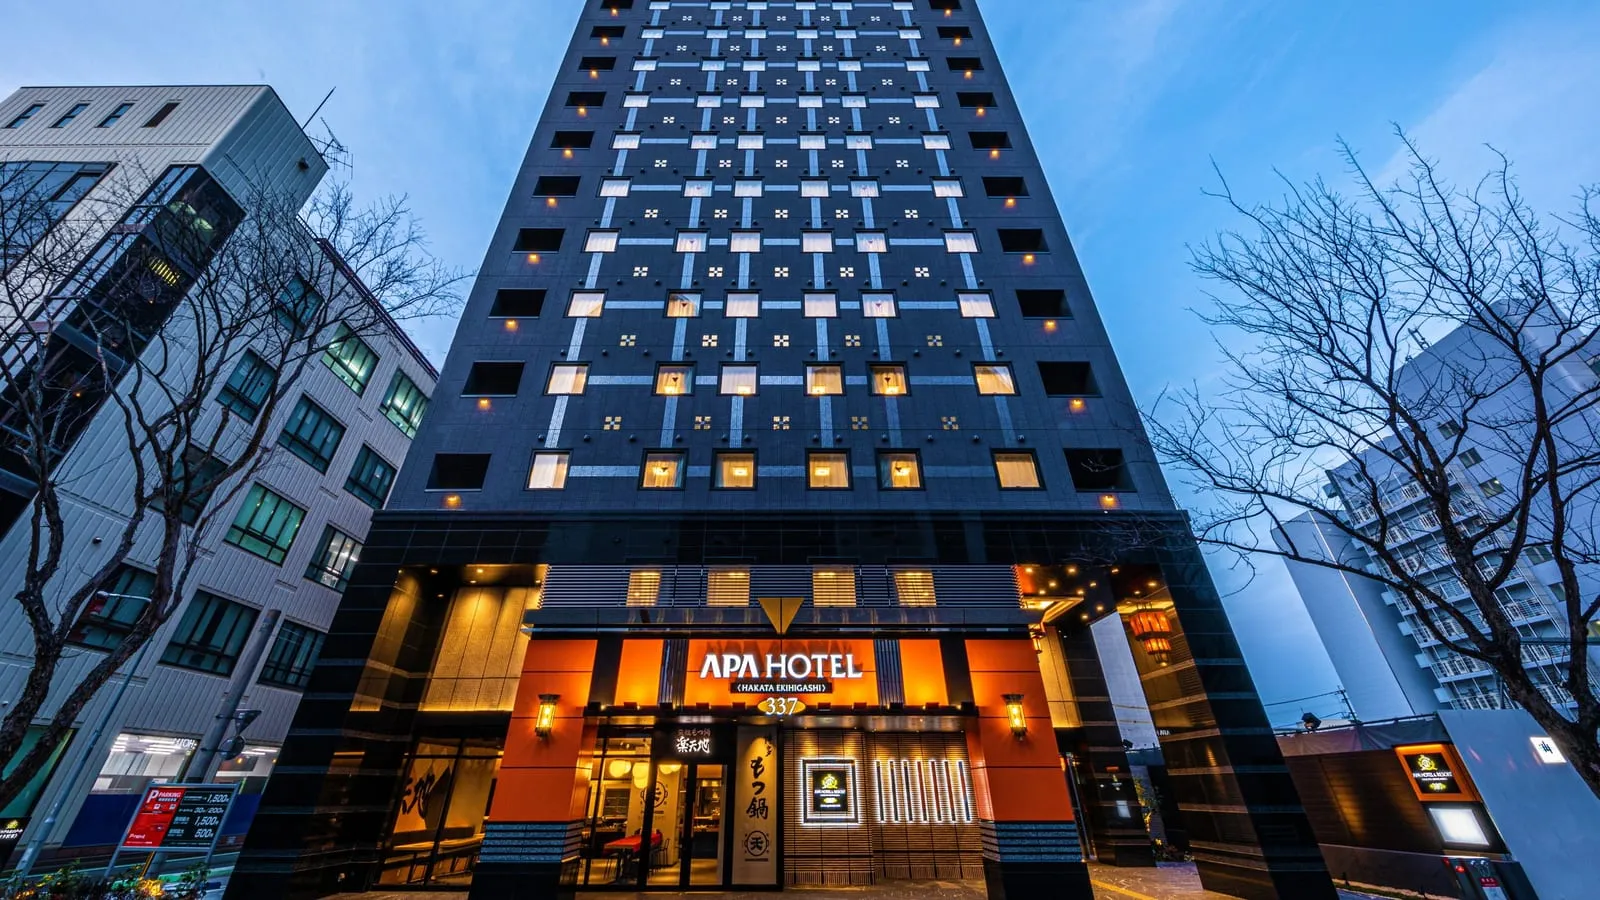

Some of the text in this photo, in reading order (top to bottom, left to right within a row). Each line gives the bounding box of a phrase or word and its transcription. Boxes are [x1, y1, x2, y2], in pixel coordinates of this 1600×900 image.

[700, 653, 863, 679] APA HOTEL
[765, 697, 798, 715] 337
[746, 756, 768, 819] もつ鍋
